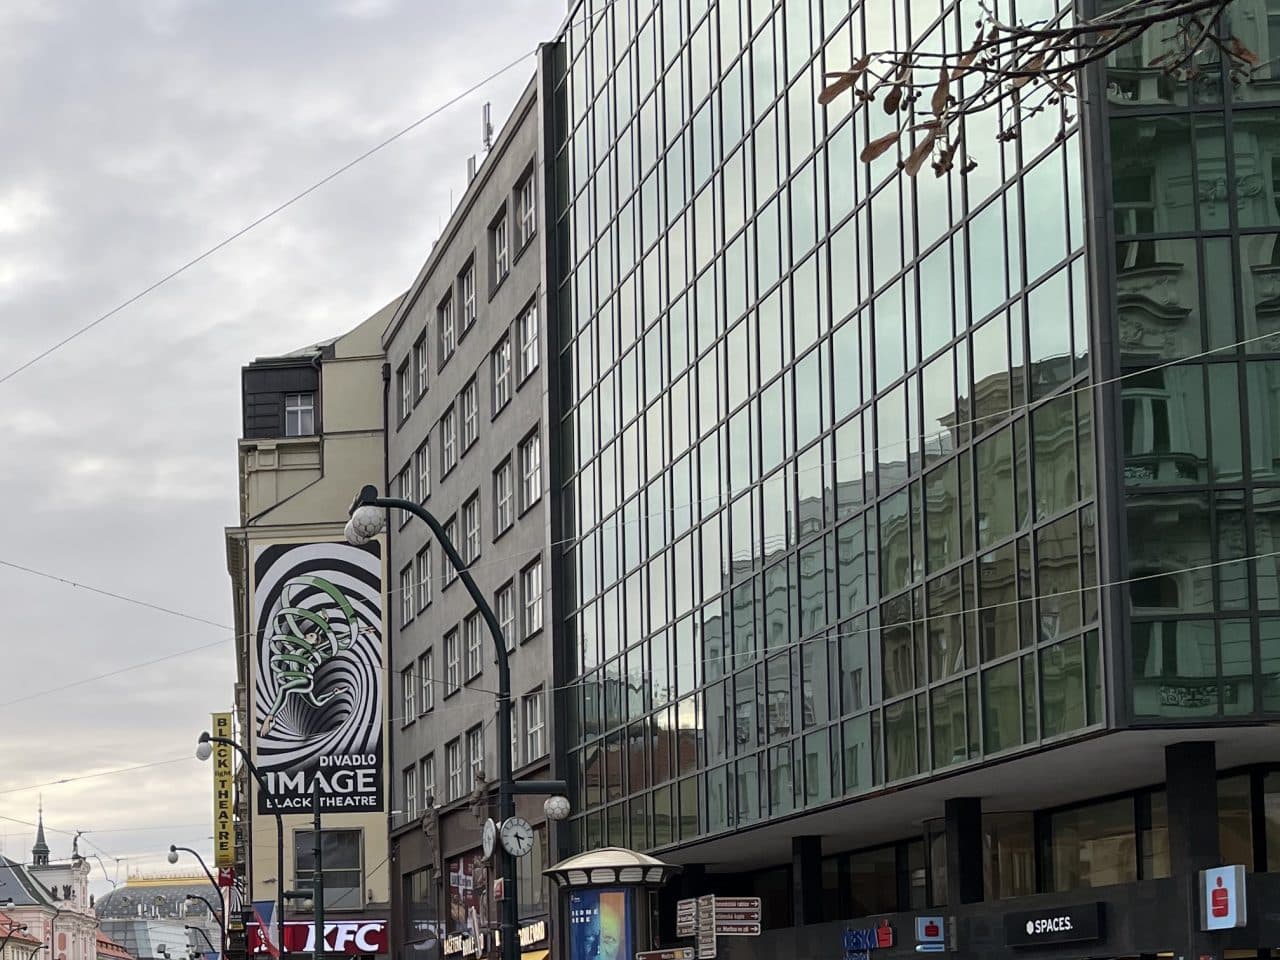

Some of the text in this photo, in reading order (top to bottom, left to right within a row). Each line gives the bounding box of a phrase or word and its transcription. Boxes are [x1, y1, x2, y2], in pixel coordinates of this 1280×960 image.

[319, 754, 377, 766] DIVADLO
[265, 768, 377, 795] IMAGE
[320, 796, 377, 806] THEATRE
[218, 780, 229, 850] THEATRE
[303, 924, 382, 951] KFC
